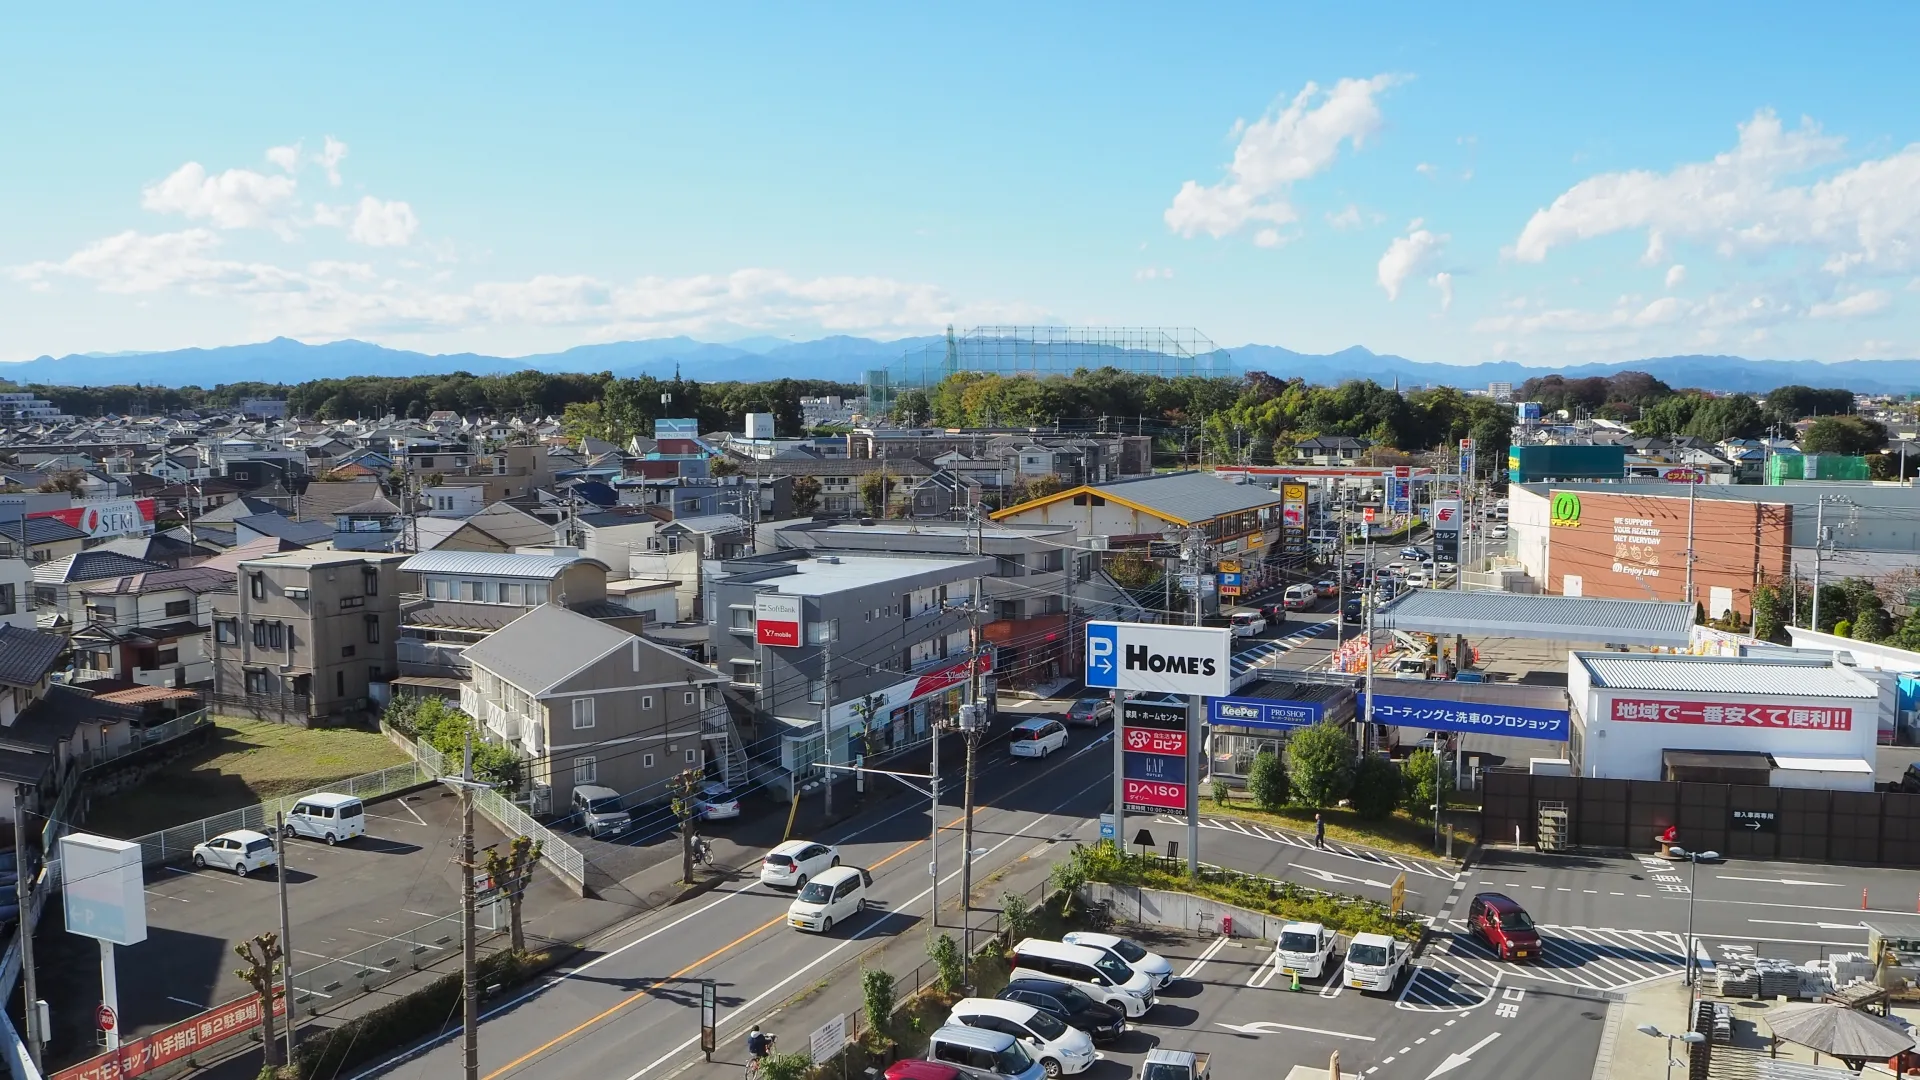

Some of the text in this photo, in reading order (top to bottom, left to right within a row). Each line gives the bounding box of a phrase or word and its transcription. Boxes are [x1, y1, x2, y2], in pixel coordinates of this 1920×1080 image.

[1613, 517, 1653, 527] WE SUPPORT
[1613, 526, 1660, 536] YOUR HEALTHY
[1613, 534, 1660, 545] DIET EVERYDAY
[1622, 566, 1660, 576] Enjoy Life!
[1224, 574, 1234, 584] P
[768, 604, 796, 614] SoftBank
[764, 628, 792, 638] Y!mobile
[1090, 636, 1112, 667] P
[1222, 704, 1260, 718] KeePer
[1271, 708, 1306, 718] PRO SHOP
[1154, 740, 1182, 750] ロピア
[1146, 758, 1164, 774] GAP
[1129, 782, 1179, 798] DAISO
[201, 1004, 257, 1038] 第2駐車場
